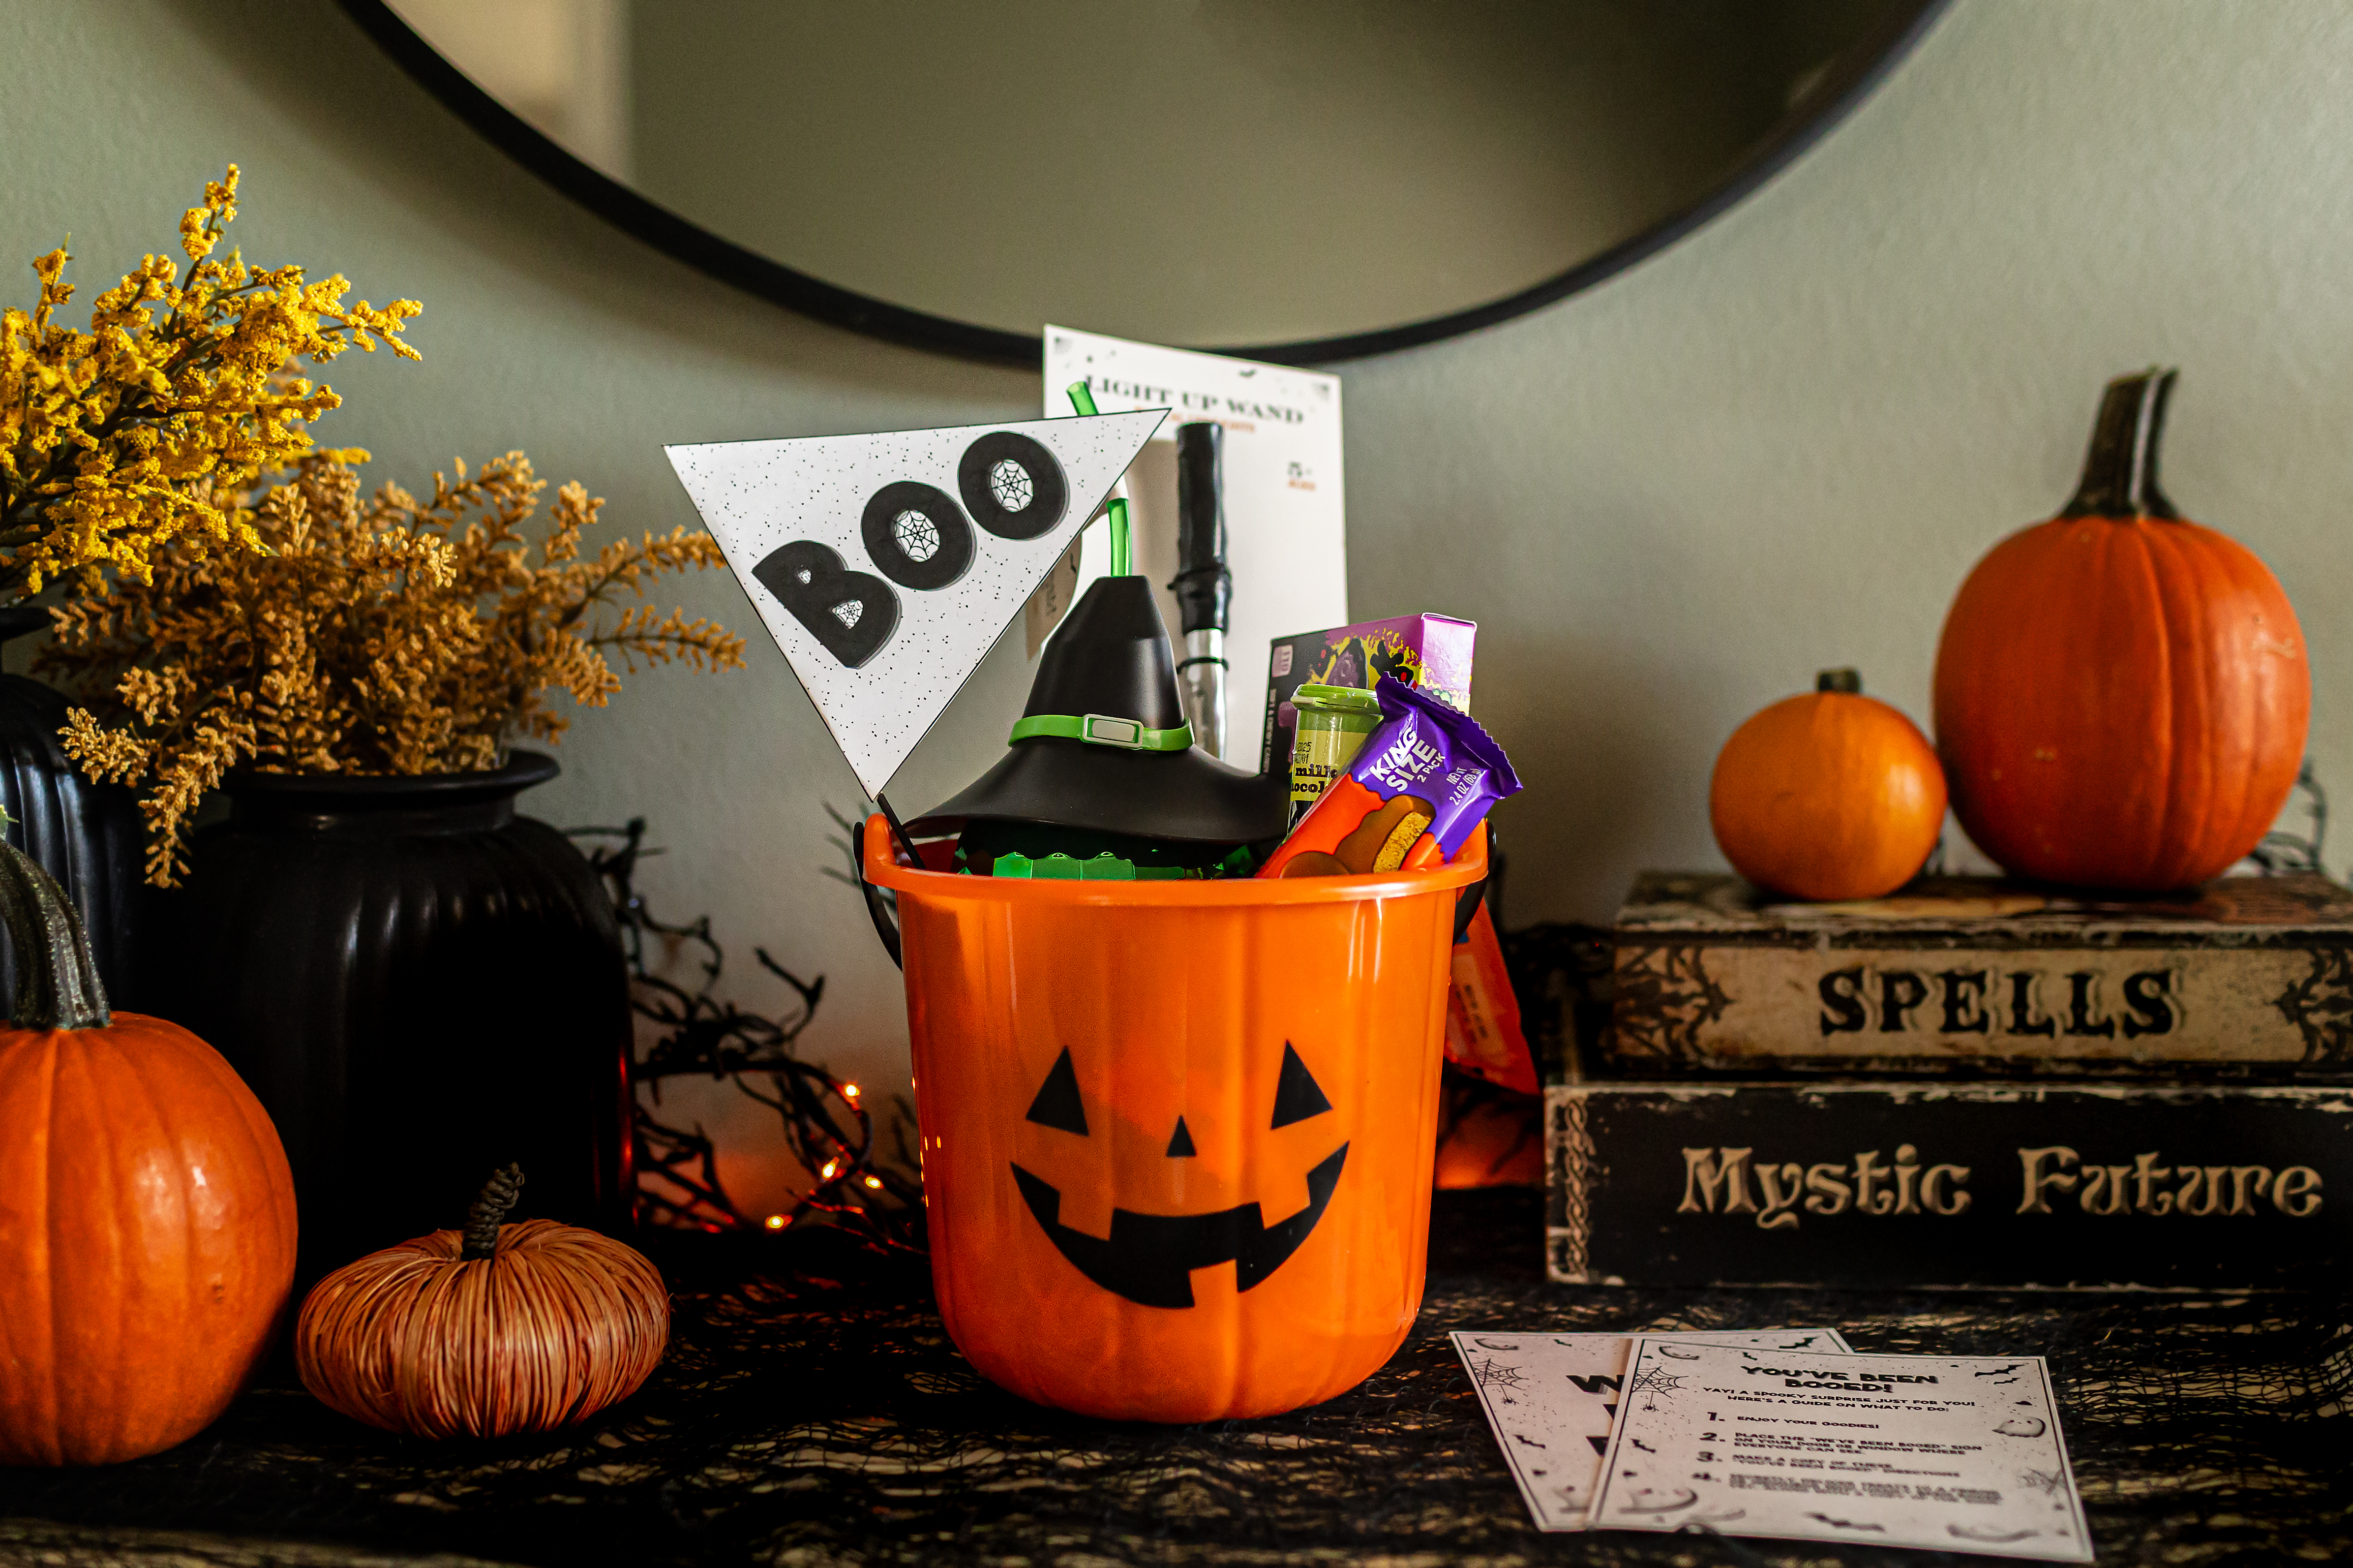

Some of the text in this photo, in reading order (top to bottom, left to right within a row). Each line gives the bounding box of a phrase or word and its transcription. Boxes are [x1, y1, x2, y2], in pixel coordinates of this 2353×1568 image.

[1084, 375, 1173, 404] LIGHT
[1182, 392, 1219, 410] UP
[1226, 397, 1305, 423] WAND
[752, 430, 1070, 669] BOO
[1369, 726, 1417, 782] KING
[1386, 740, 1437, 792] SIZE
[1417, 752, 1445, 782] 2 PACK
[1449, 790, 1463, 806] 2.4
[1457, 781, 1469, 795] OZ
[1817, 964, 2176, 1040] SPELLS
[1676, 1143, 2324, 1229] Mystic Future
[1740, 1366, 1939, 1384] YOU'VE BEEN
[1785, 1378, 1894, 1393] BOOED!
[1811, 1395, 1871, 1403] SURPRISE
[1707, 1411, 1726, 1422] 1.
[1699, 1432, 1726, 1442] 2.
